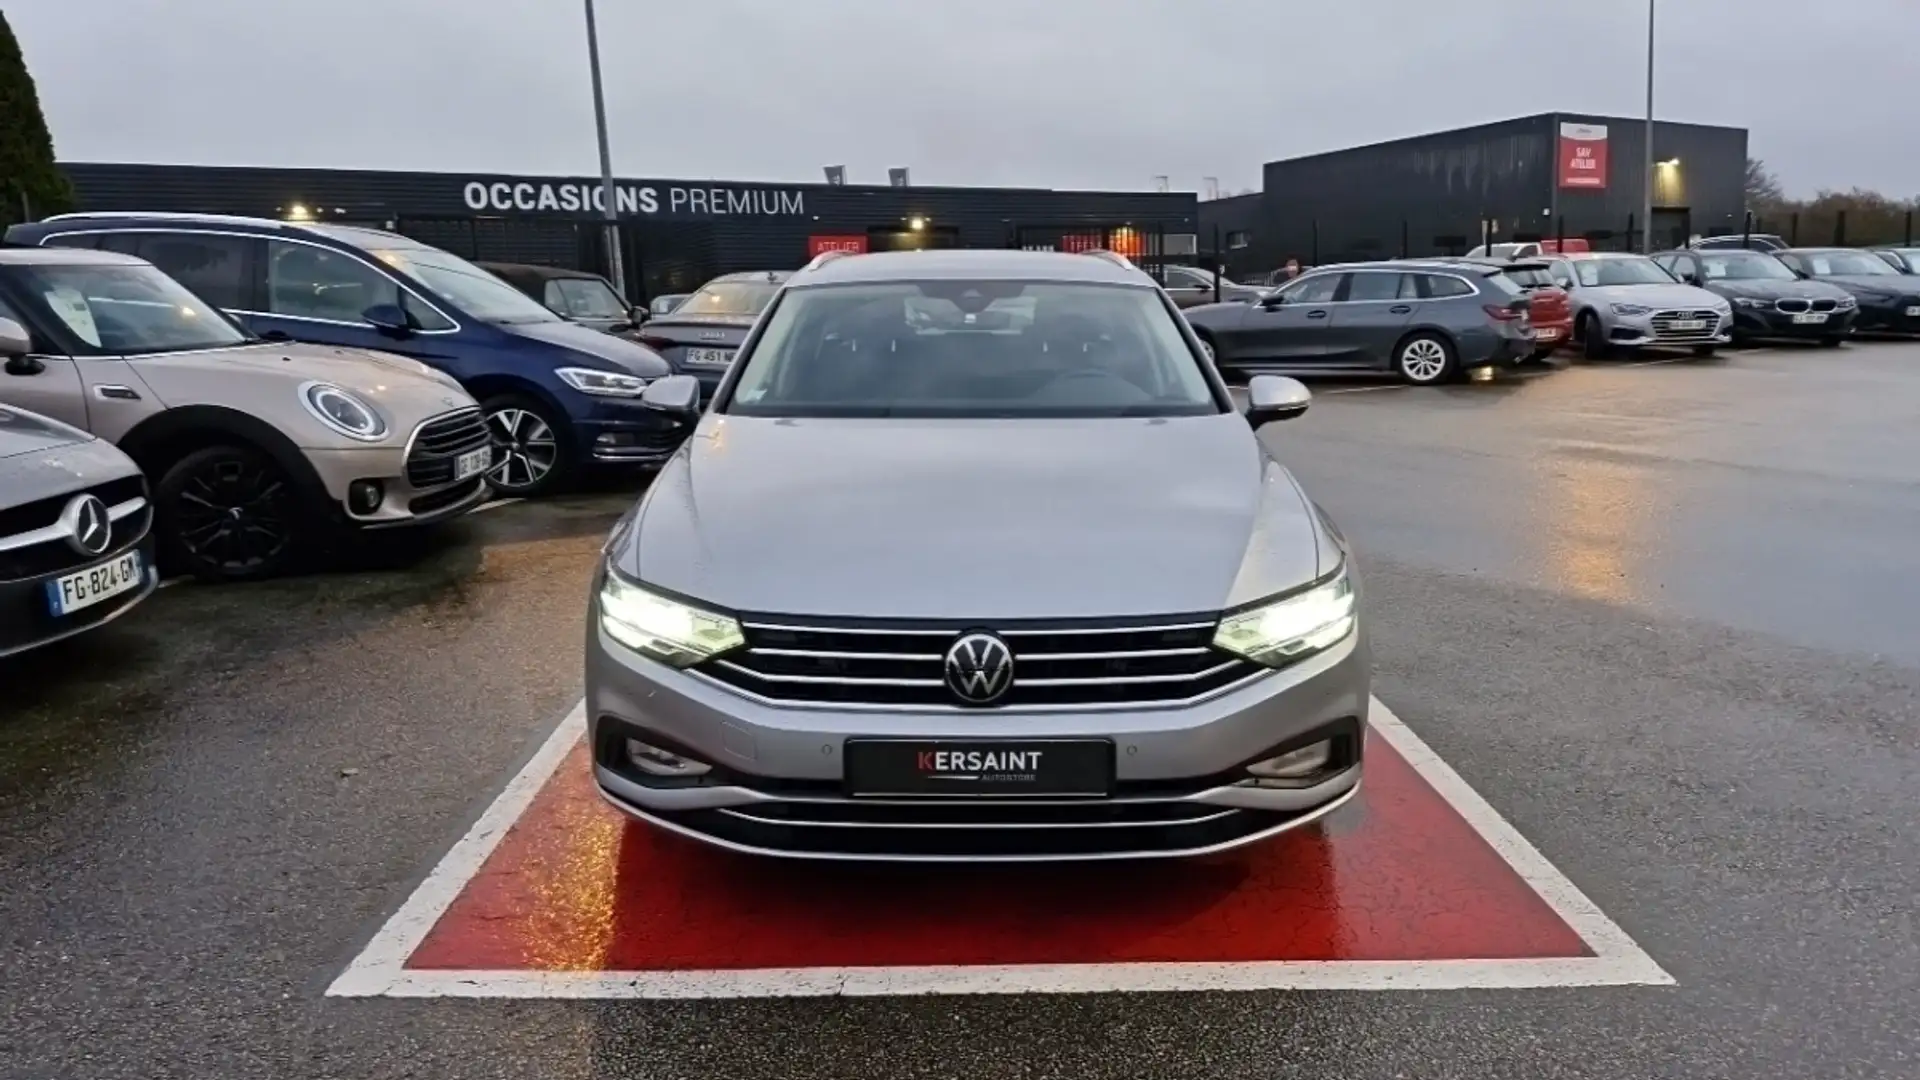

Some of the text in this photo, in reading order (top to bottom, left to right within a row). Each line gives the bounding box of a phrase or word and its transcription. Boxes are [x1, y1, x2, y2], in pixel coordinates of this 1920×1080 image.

[463, 181, 804, 215] OCCASIONS PREMIUM
[917, 751, 1043, 771] KERSAINT
